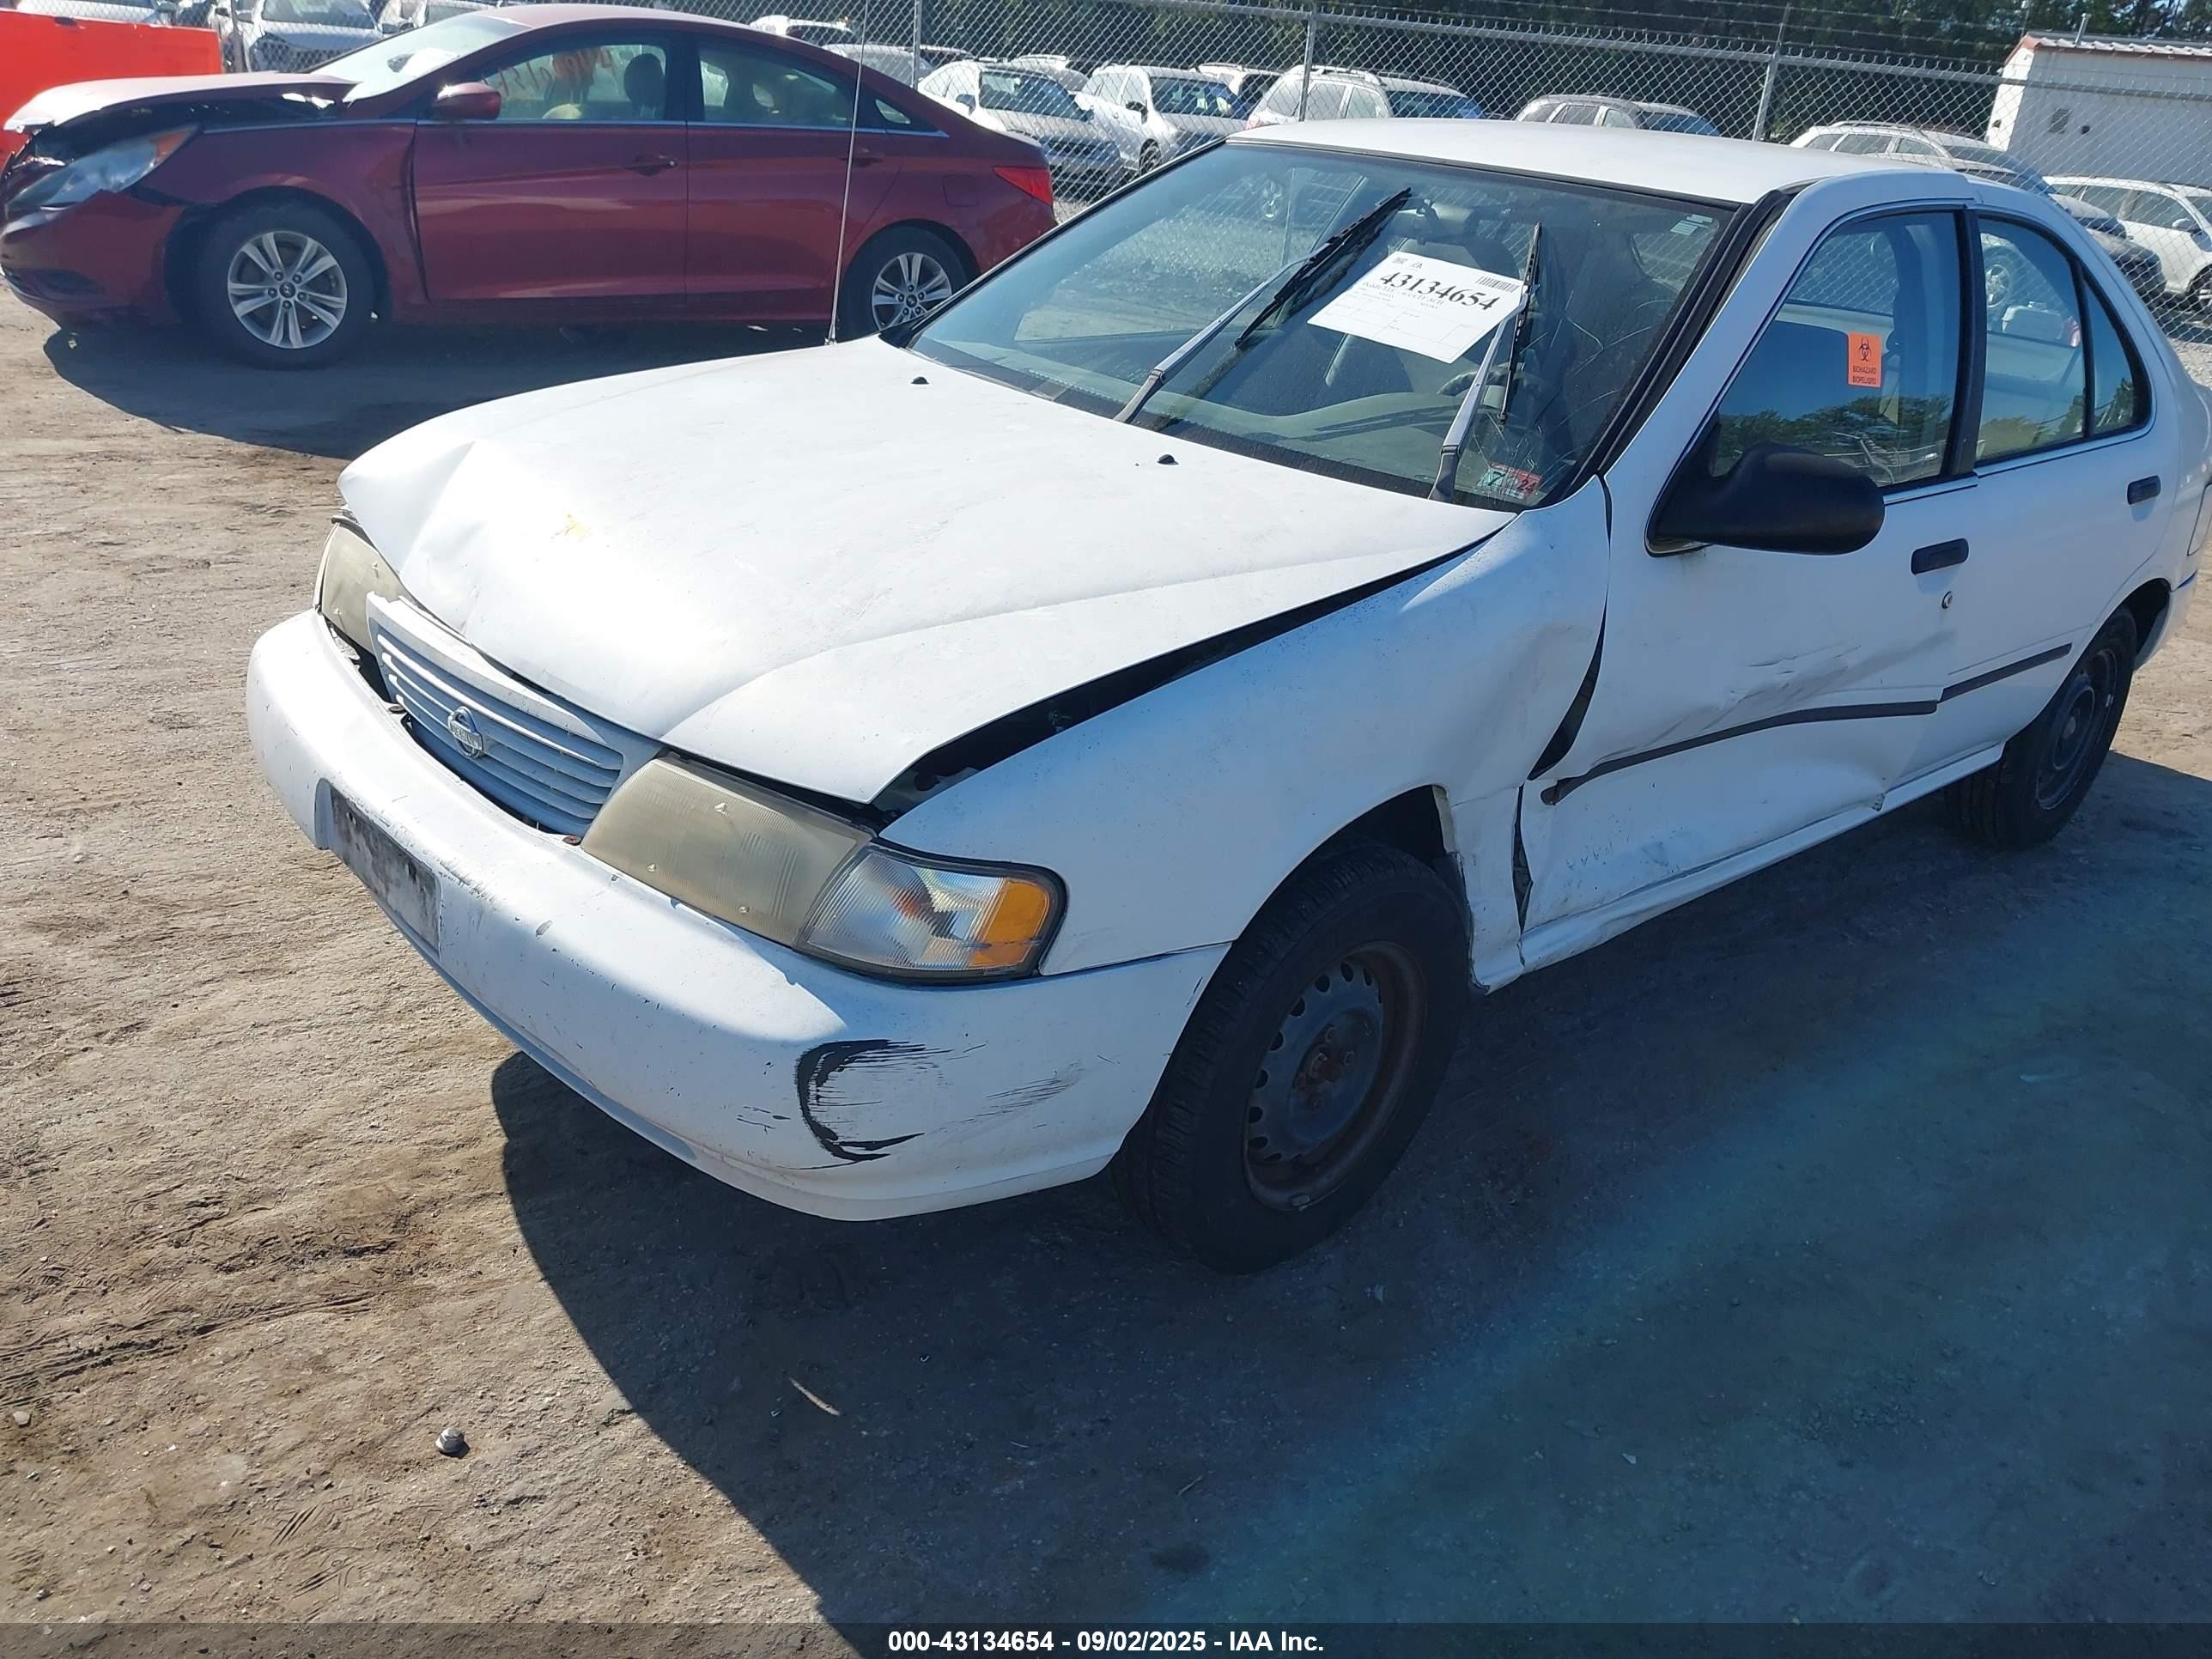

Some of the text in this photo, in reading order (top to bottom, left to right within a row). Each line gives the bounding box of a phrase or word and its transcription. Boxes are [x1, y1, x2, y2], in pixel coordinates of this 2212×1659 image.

[1379, 271, 1501, 311] 43134654
[1487, 471, 1506, 487] 7
[1516, 479, 1536, 492] 24
